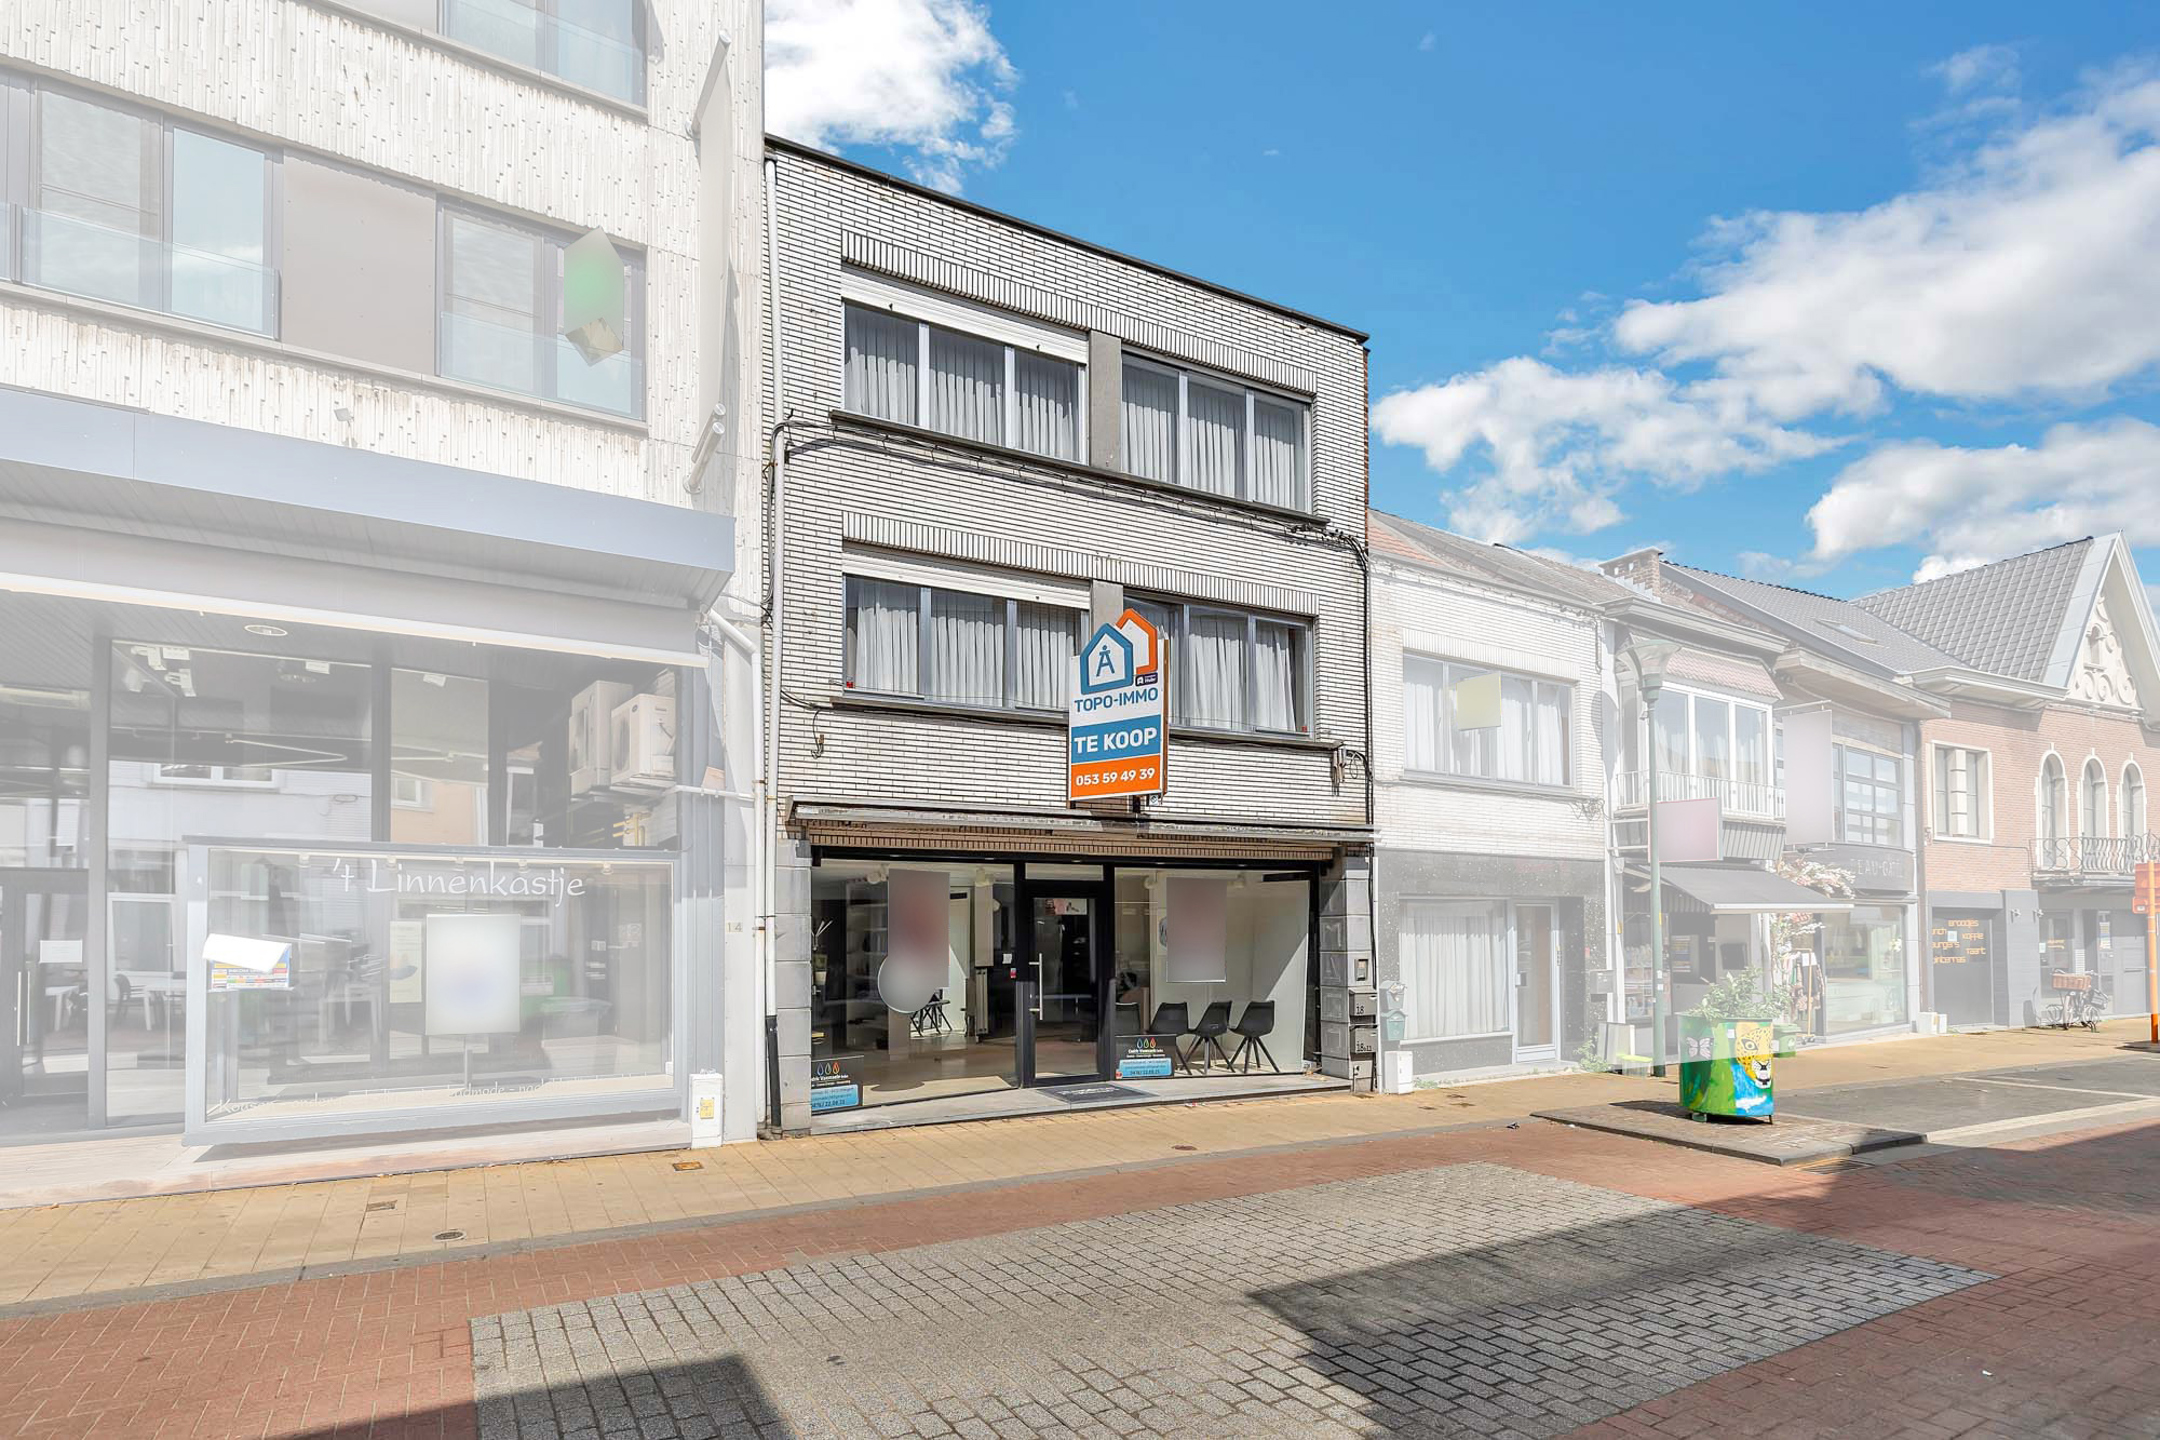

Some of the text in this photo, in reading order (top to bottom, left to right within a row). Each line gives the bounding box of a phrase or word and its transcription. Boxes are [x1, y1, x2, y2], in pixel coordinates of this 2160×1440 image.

[1074, 687, 1158, 713] TOPO-IMMO
[1074, 727, 1158, 754] TE KOOP
[1075, 767, 1155, 786] 053 59 49 39
[333, 858, 586, 908] 't Linnenkastje
[727, 921, 742, 933] 14
[1356, 1005, 1365, 1015] 18
